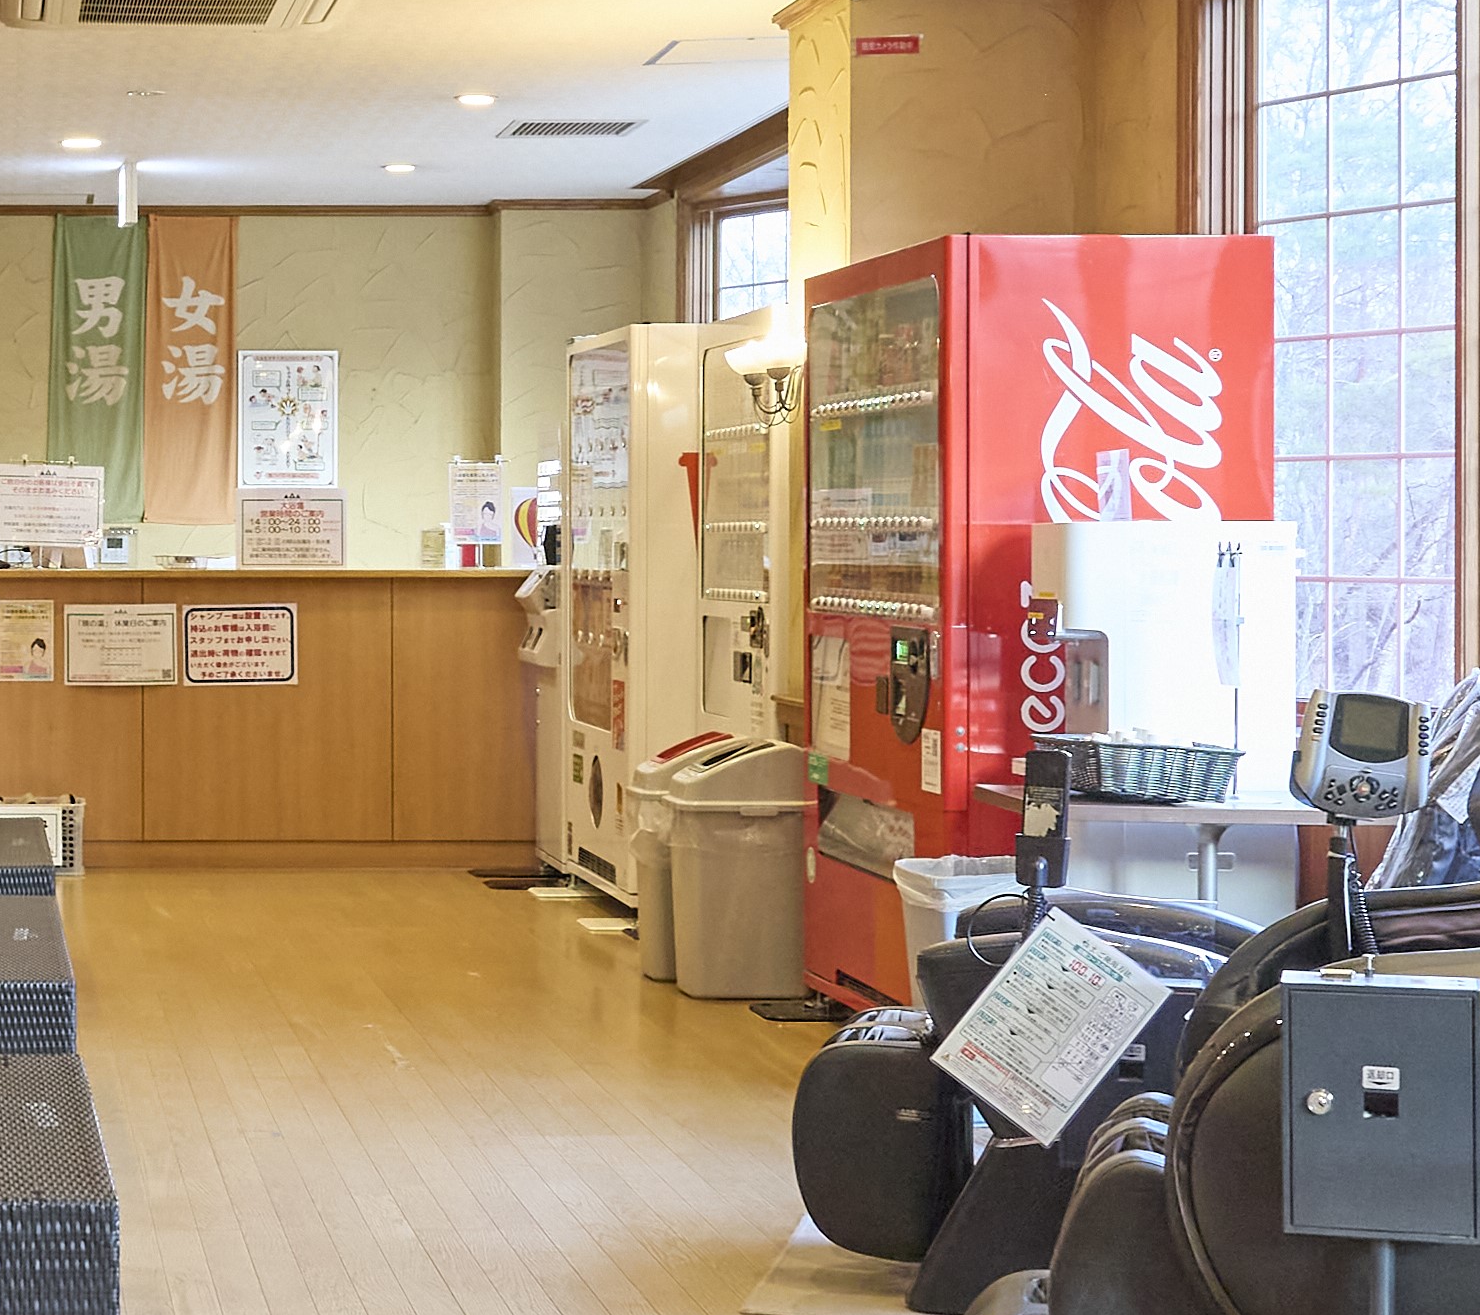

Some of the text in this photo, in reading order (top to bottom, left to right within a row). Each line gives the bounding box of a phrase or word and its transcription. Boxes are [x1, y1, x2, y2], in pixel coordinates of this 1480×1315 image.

[65, 276, 129, 406] 男湯
[161, 275, 226, 405] 女湯
[190, 624, 277, 633] 持込のお客様は入浴前に
